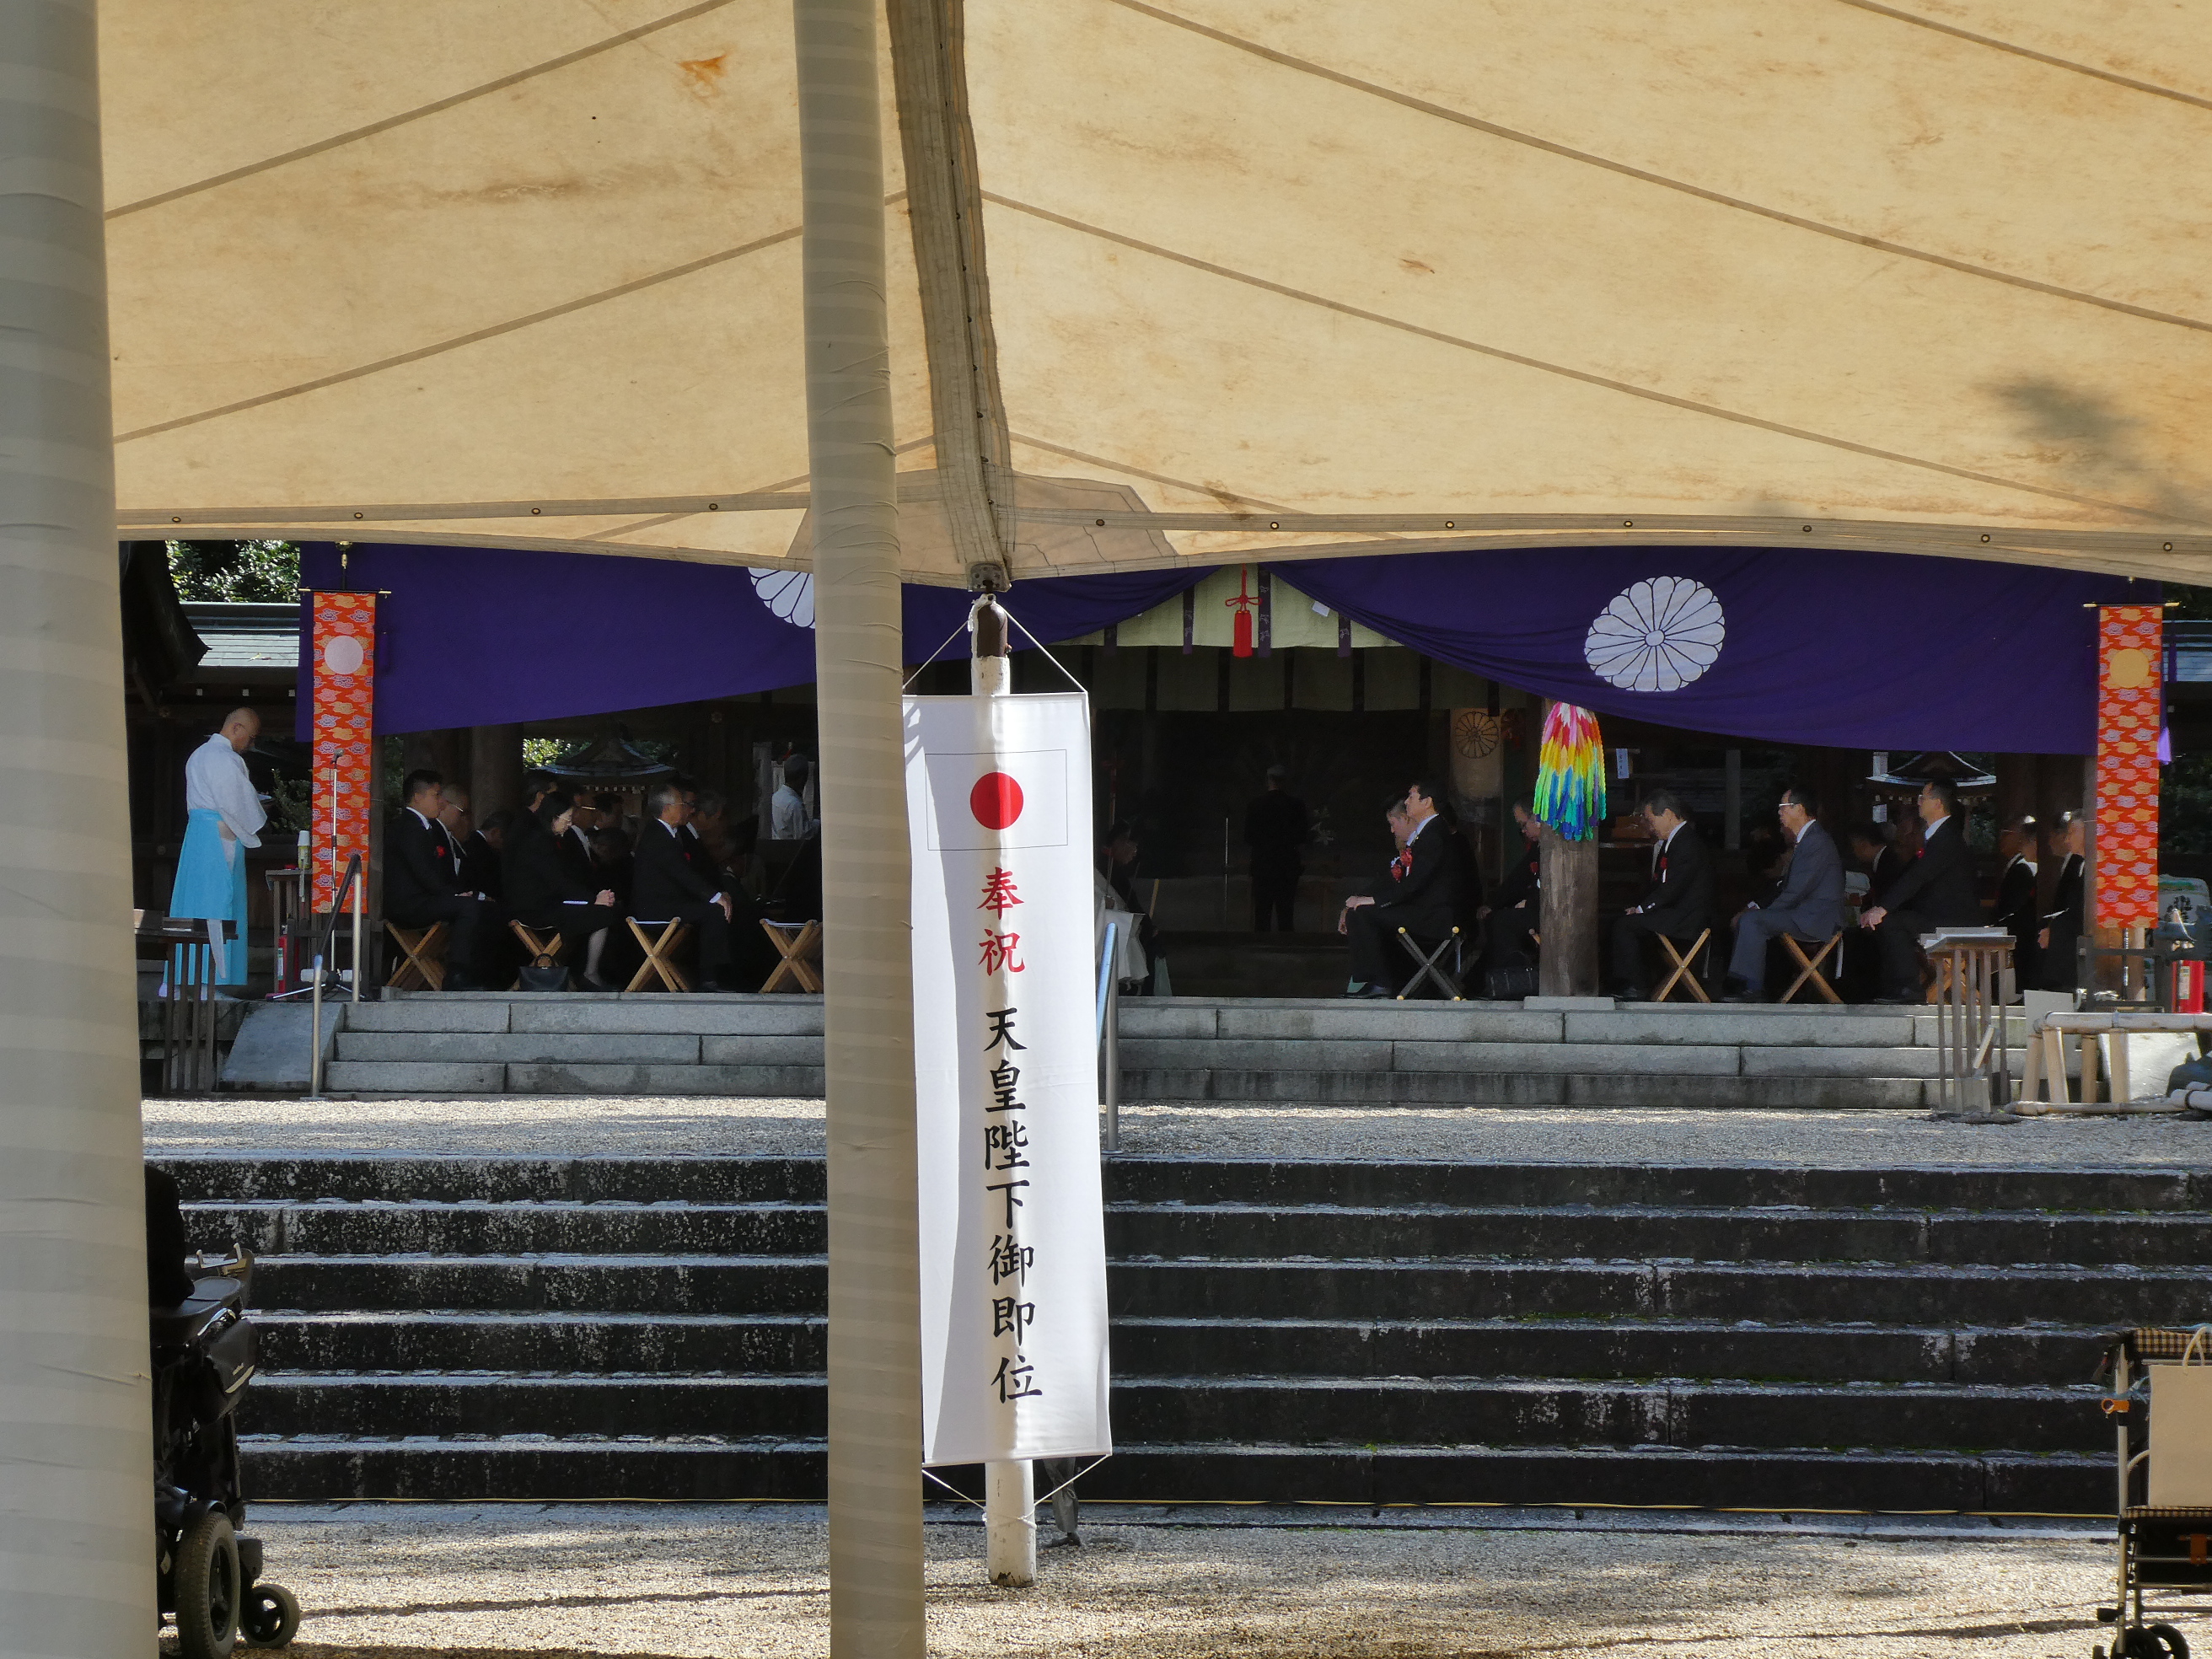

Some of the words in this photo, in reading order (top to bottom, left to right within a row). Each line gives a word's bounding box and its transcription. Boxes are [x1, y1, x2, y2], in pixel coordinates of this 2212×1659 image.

[977, 867, 1025, 976] 奉祝
[983, 1007, 1042, 1404] 天皇陛下御即位
